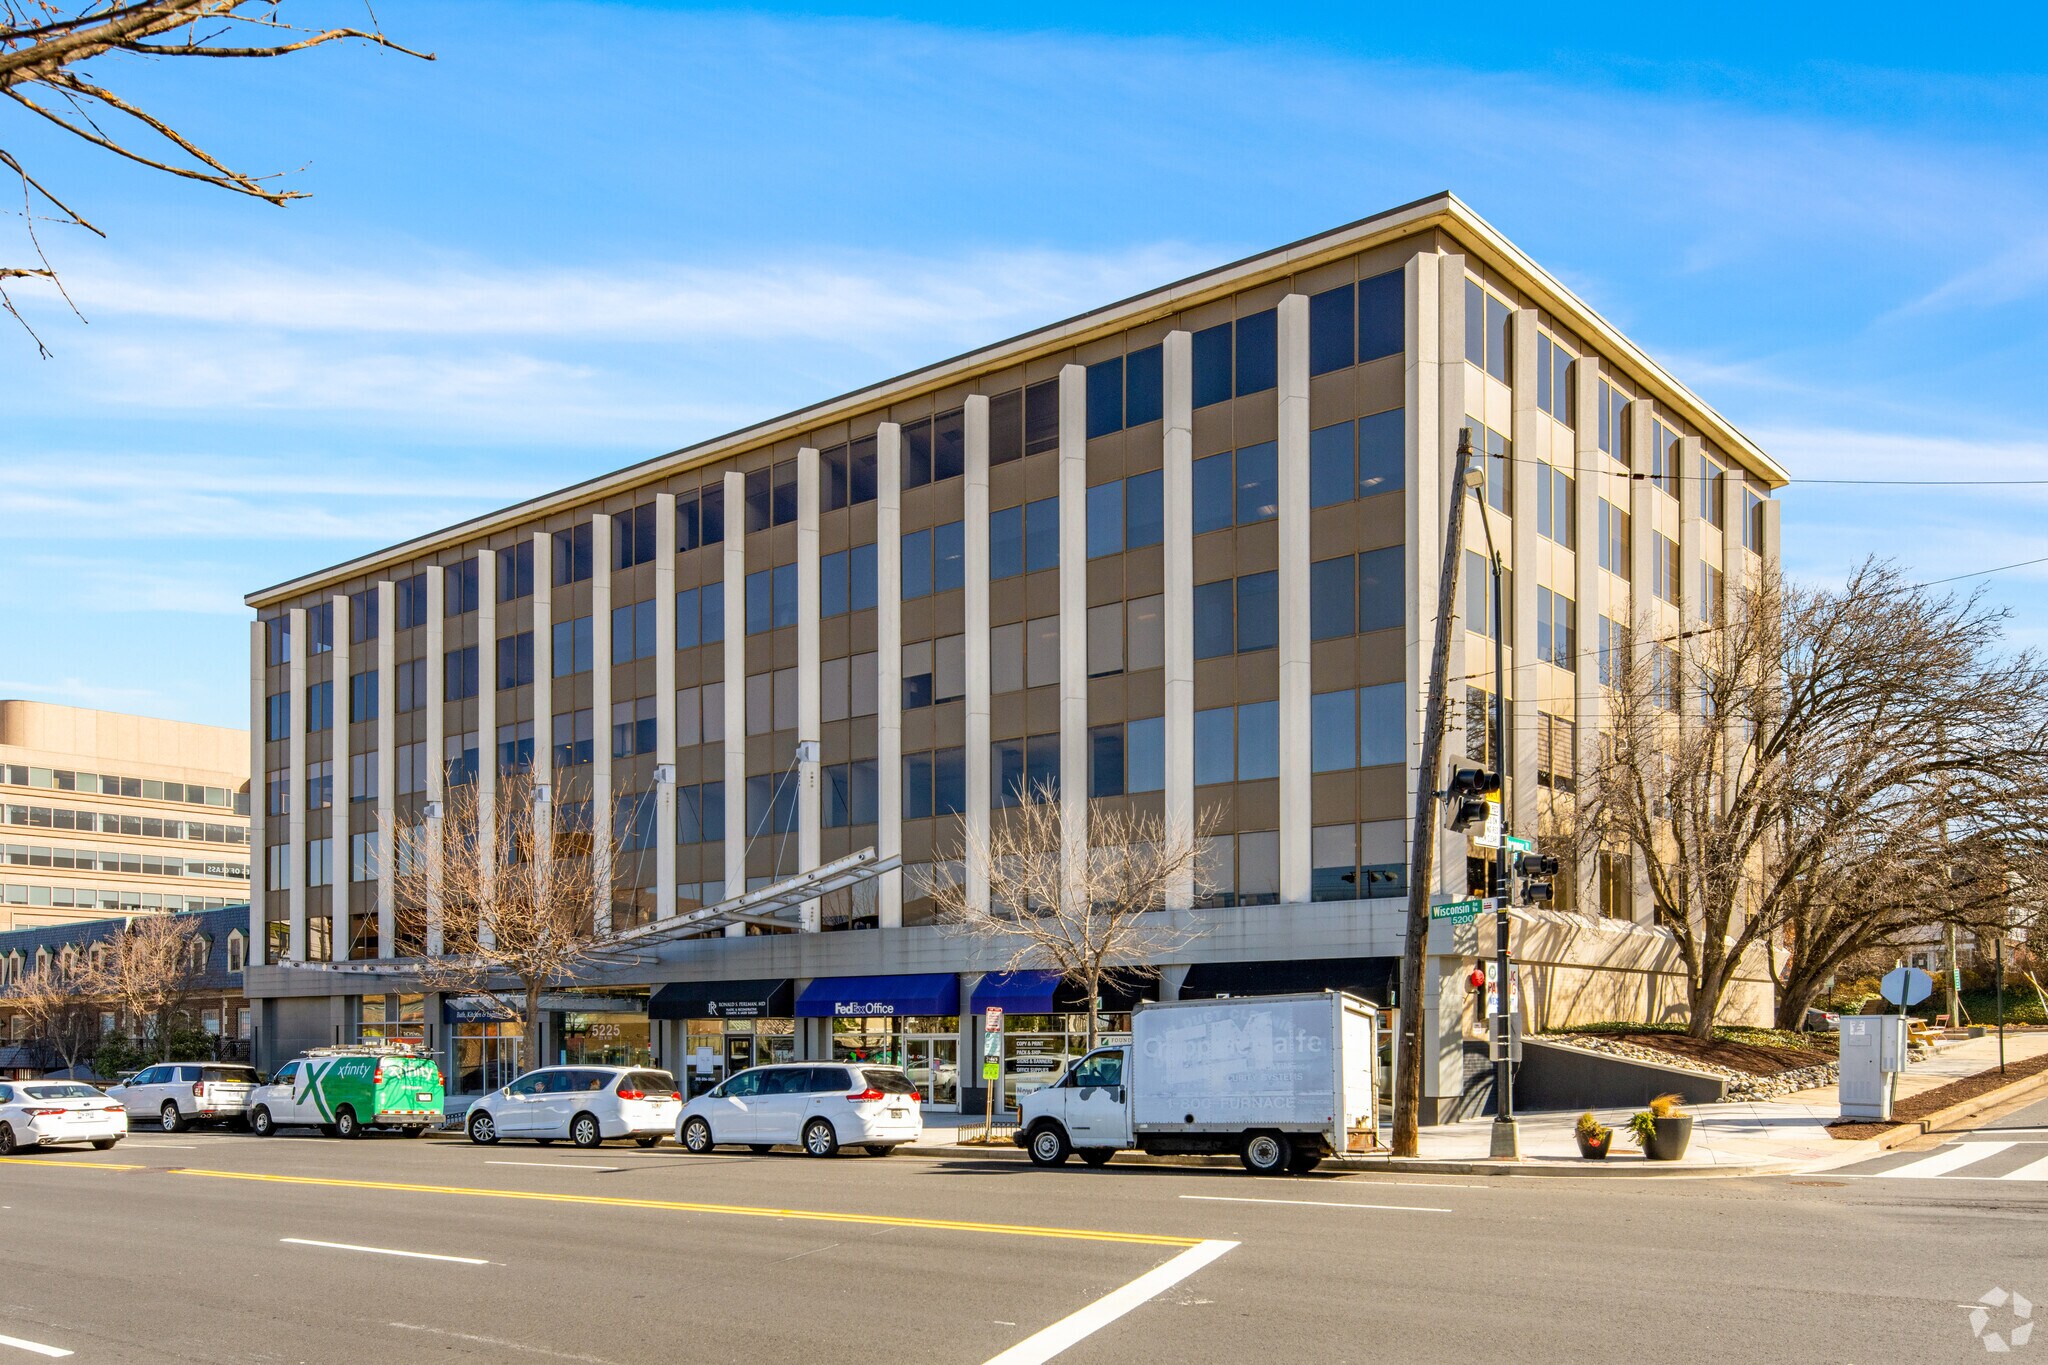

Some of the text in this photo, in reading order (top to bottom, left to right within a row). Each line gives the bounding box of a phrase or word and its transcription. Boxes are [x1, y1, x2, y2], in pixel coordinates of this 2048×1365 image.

[1433, 902, 1470, 917] Wisconsin
[1452, 914, 1474, 924] 5200
[835, 1002, 894, 1015] FedEx Office
[592, 1024, 620, 1036] 5225
[338, 1062, 371, 1079] xfinity
[389, 1062, 433, 1080] xfinity
